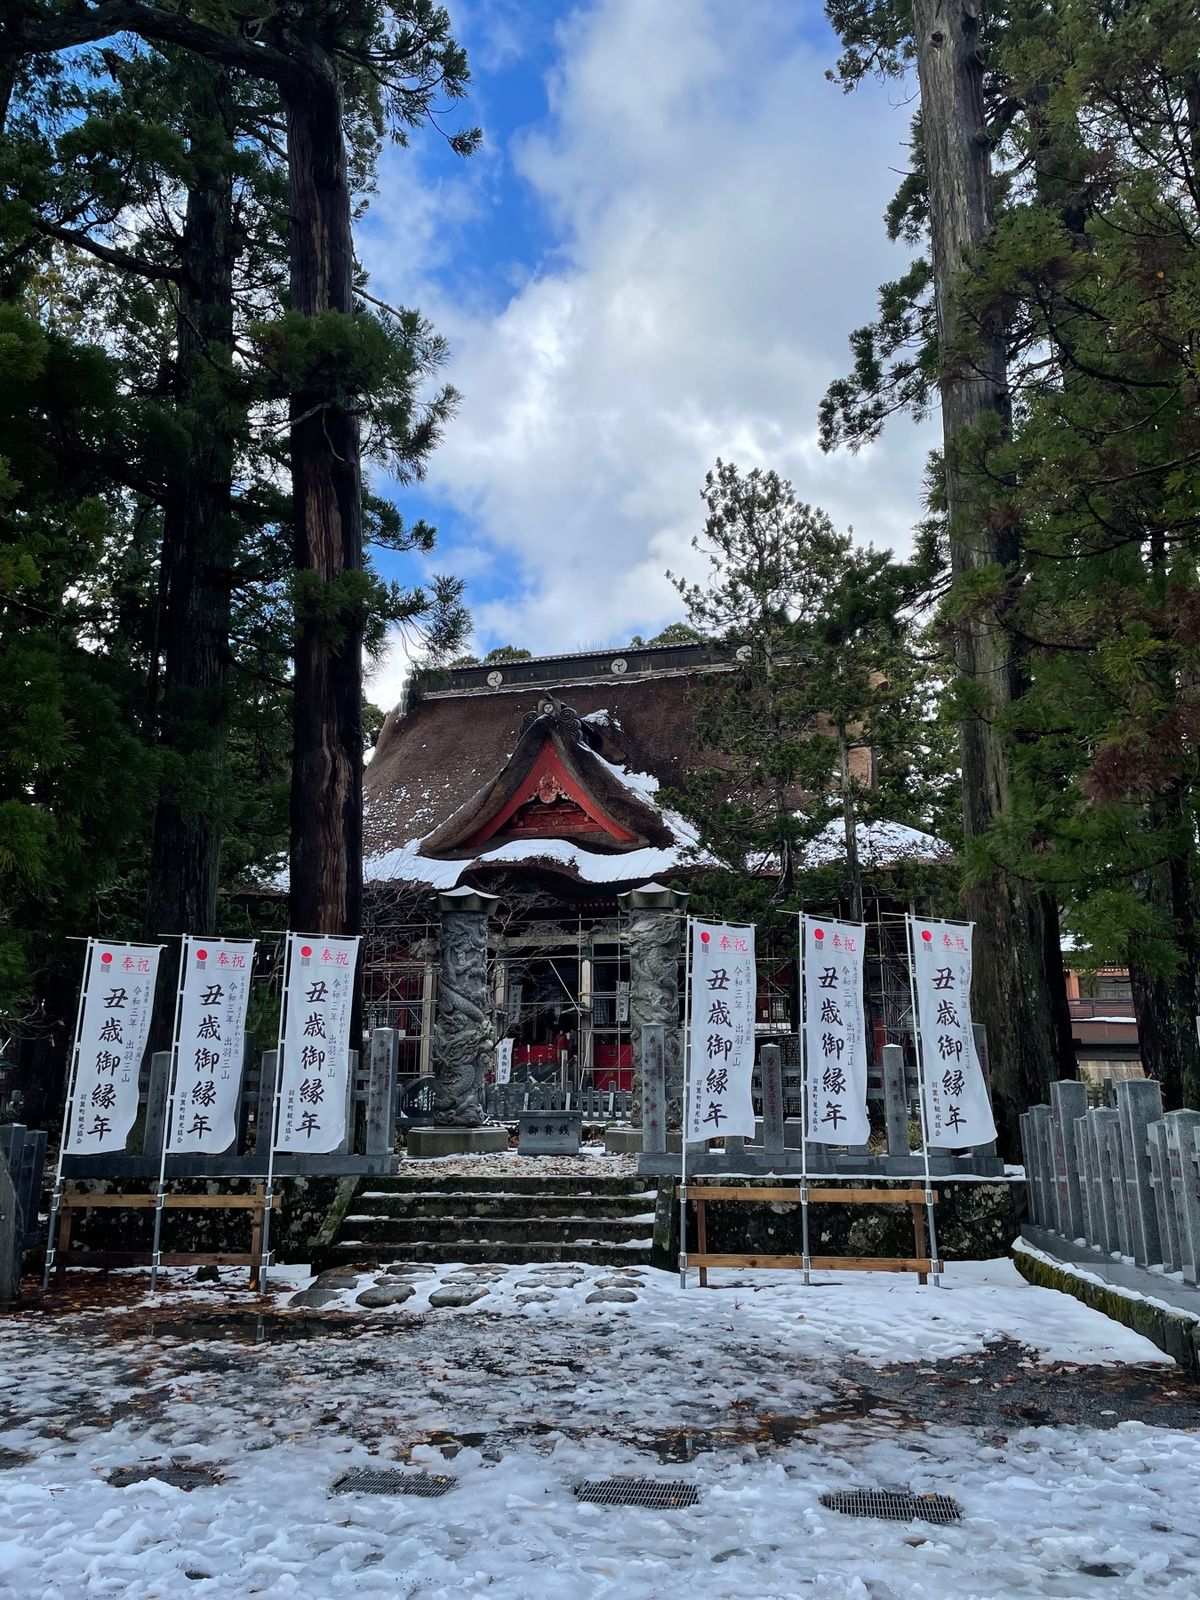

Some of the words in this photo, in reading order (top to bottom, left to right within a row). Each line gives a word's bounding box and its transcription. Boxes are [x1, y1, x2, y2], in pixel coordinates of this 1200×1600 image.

[121, 956, 150, 972] 奉祝
[216, 952, 246, 968] 奉祝
[320, 948, 349, 966] 奉祝
[719, 935, 748, 952] 奉祝
[831, 933, 857, 952] 奉祝
[941, 933, 969, 951] 奉祝
[128, 985, 142, 1027] 令和三年
[226, 981, 238, 1024] 令和三年
[330, 978, 341, 1022] 令和三年
[733, 965, 744, 1010] 令和三年
[841, 965, 853, 1009] 令和三年
[87, 988, 129, 1142] 丑歳御縁年
[121, 1040, 134, 1083] 出羽三山
[187, 983, 225, 1140] 丑歳御縁年
[221, 1036, 232, 1080] 出羽三山
[295, 980, 329, 1139] 丑歳御縁年
[327, 1034, 337, 1078] 出羽三山
[702, 968, 733, 1129] 丑歳御縁年
[818, 966, 847, 1131] 丑歳御縁年
[931, 966, 968, 1134] 丑歳御縁年
[528, 1124, 570, 1136] 御賽銭
